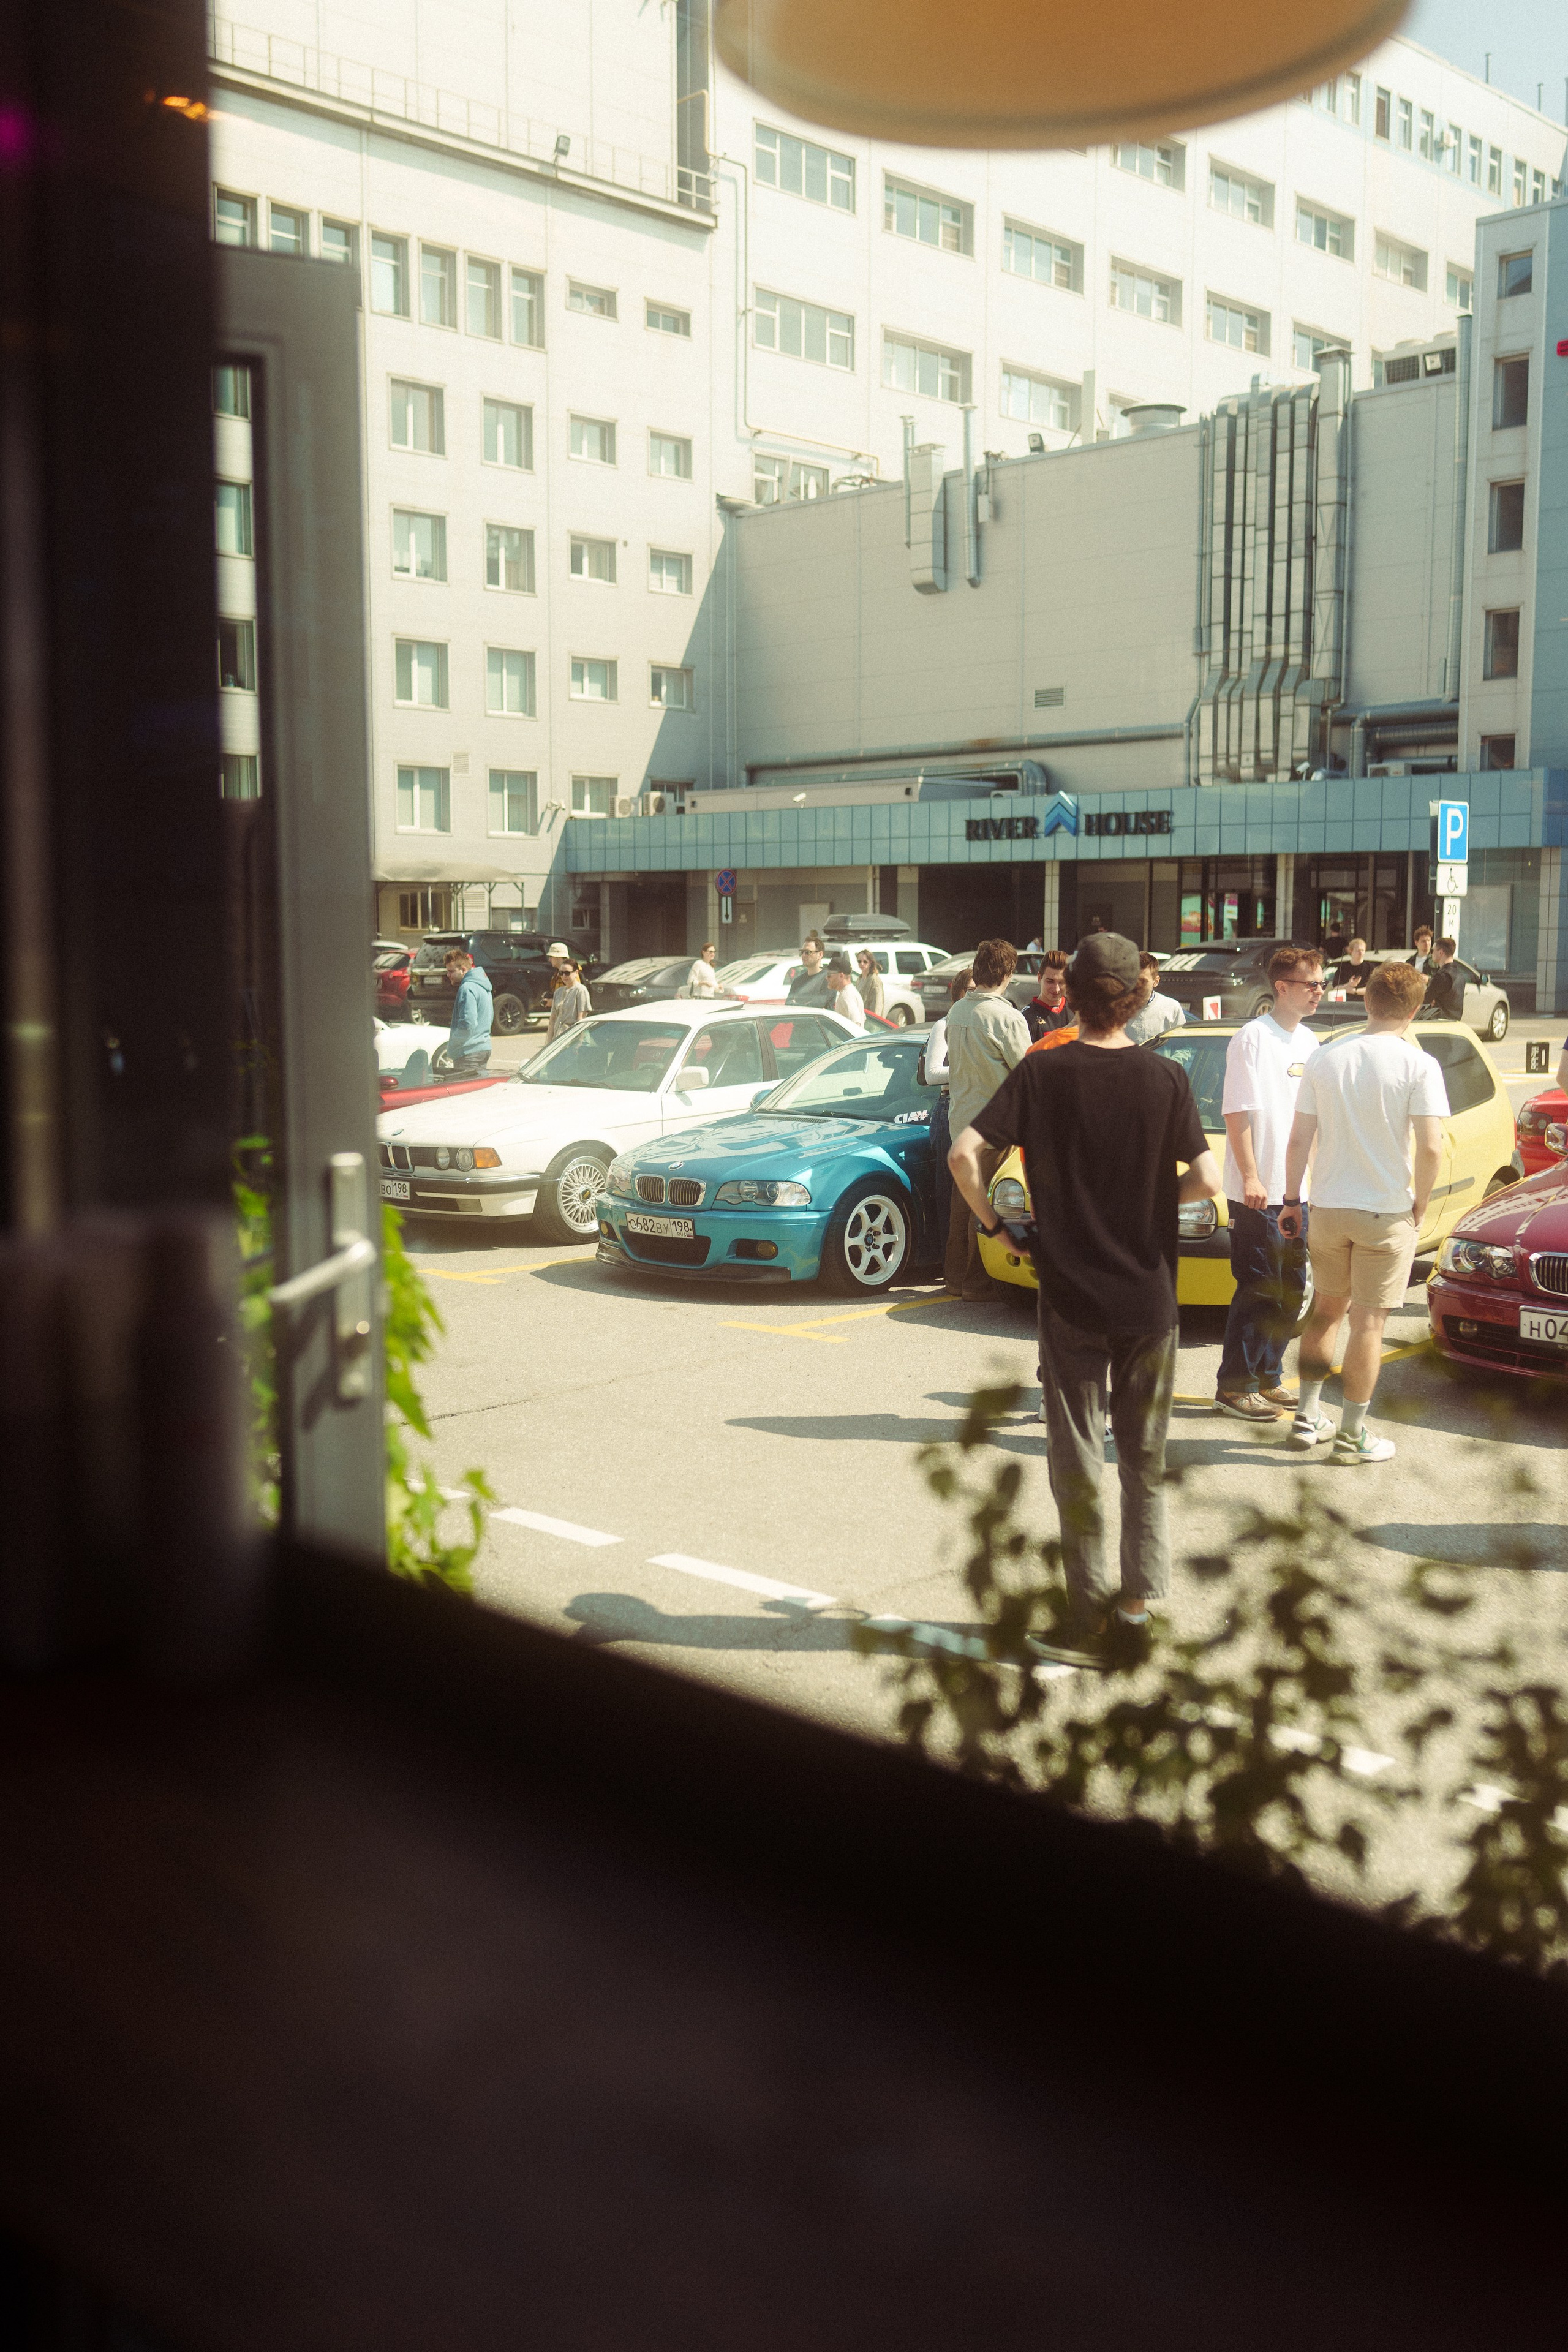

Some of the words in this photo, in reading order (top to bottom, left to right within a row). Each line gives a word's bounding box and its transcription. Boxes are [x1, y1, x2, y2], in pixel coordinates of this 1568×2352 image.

[965, 817, 1039, 841] RIVER
[1084, 810, 1172, 837] HOUSE
[1446, 808, 1464, 856] P
[1447, 905, 1457, 915] 20
[393, 1182, 407, 1193] 198
[671, 1220, 690, 1232] 198
